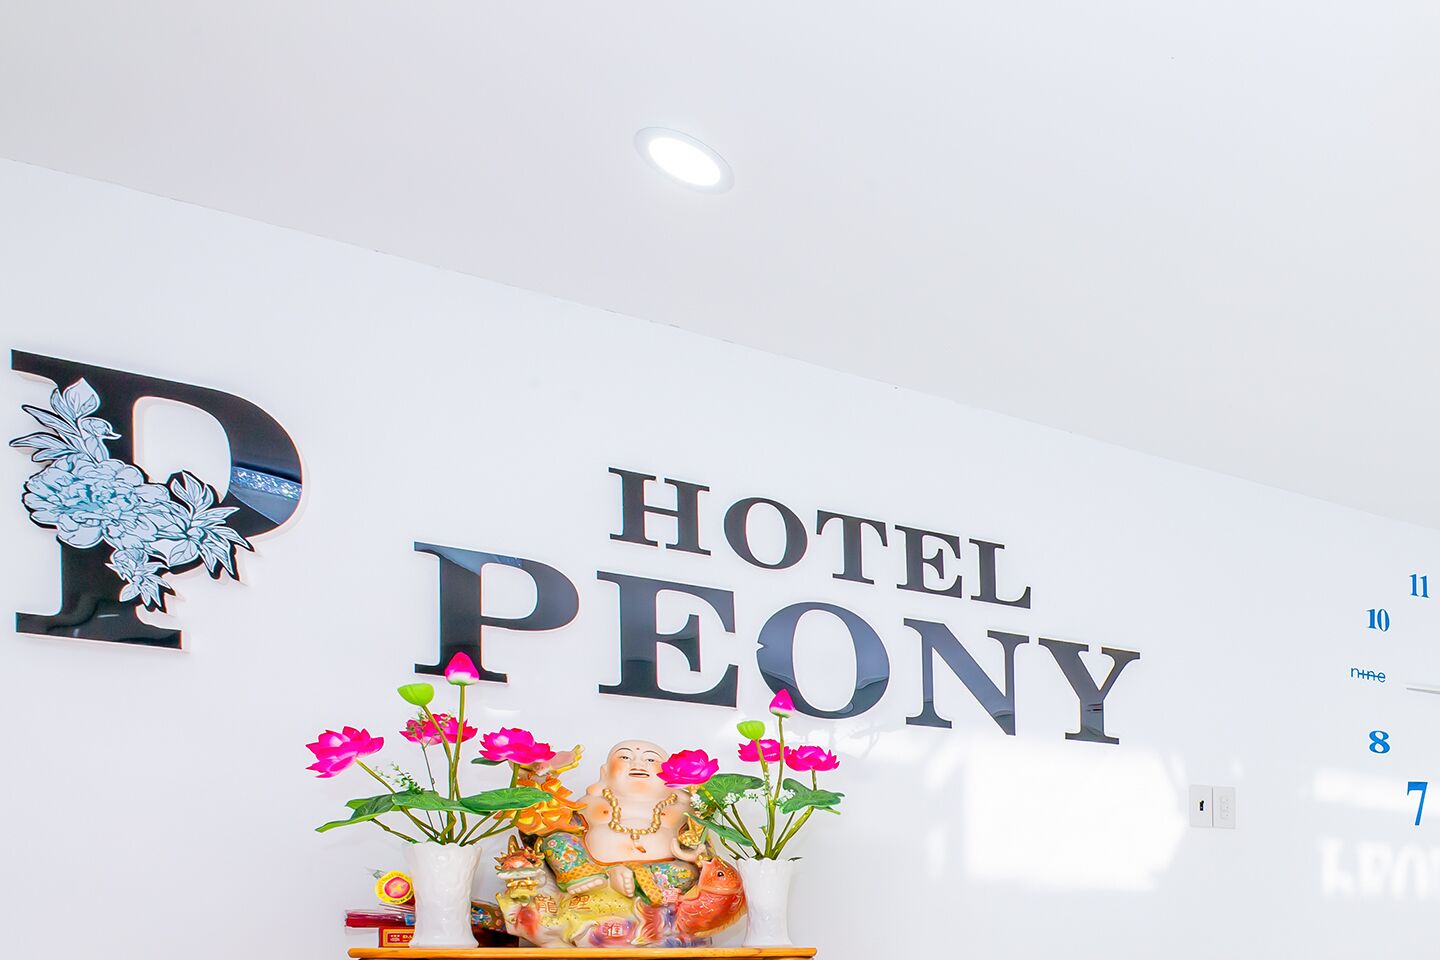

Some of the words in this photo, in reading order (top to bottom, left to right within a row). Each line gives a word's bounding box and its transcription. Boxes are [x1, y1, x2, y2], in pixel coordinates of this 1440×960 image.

[608, 466, 1031, 609] HOTEL
[1409, 574, 1430, 599] 11
[1366, 608, 1390, 632] 10
[413, 541, 1141, 745] PEONY
[1350, 667, 1386, 684] nine
[1368, 730, 1391, 754] 8
[1406, 781, 1429, 826] 7
